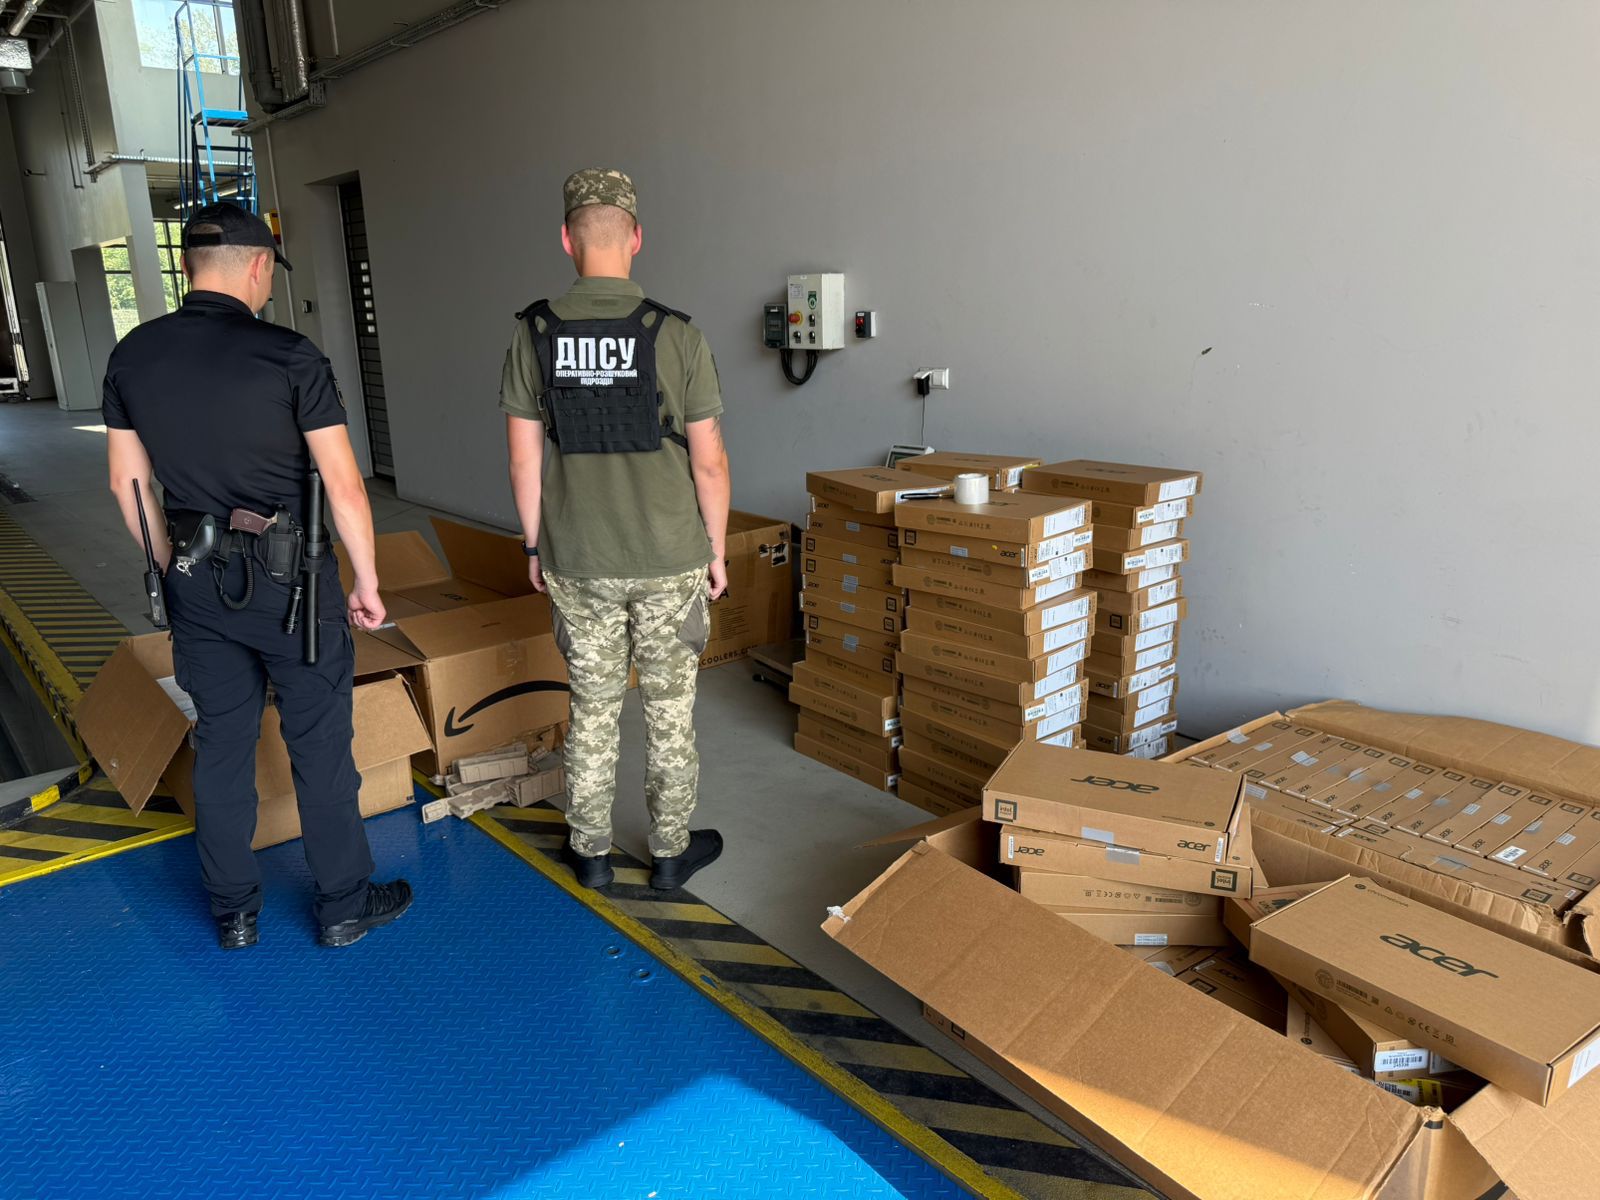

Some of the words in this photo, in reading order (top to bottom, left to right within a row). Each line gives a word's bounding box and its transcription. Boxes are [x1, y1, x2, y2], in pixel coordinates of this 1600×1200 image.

[555, 337, 636, 370] ДПСУ
[1000, 550, 1019, 558] acer
[1095, 681, 1113, 690] acer
[1070, 775, 1159, 794] acer
[1014, 846, 1046, 857] acer
[1177, 839, 1212, 852] acer
[1379, 933, 1500, 978] acer
